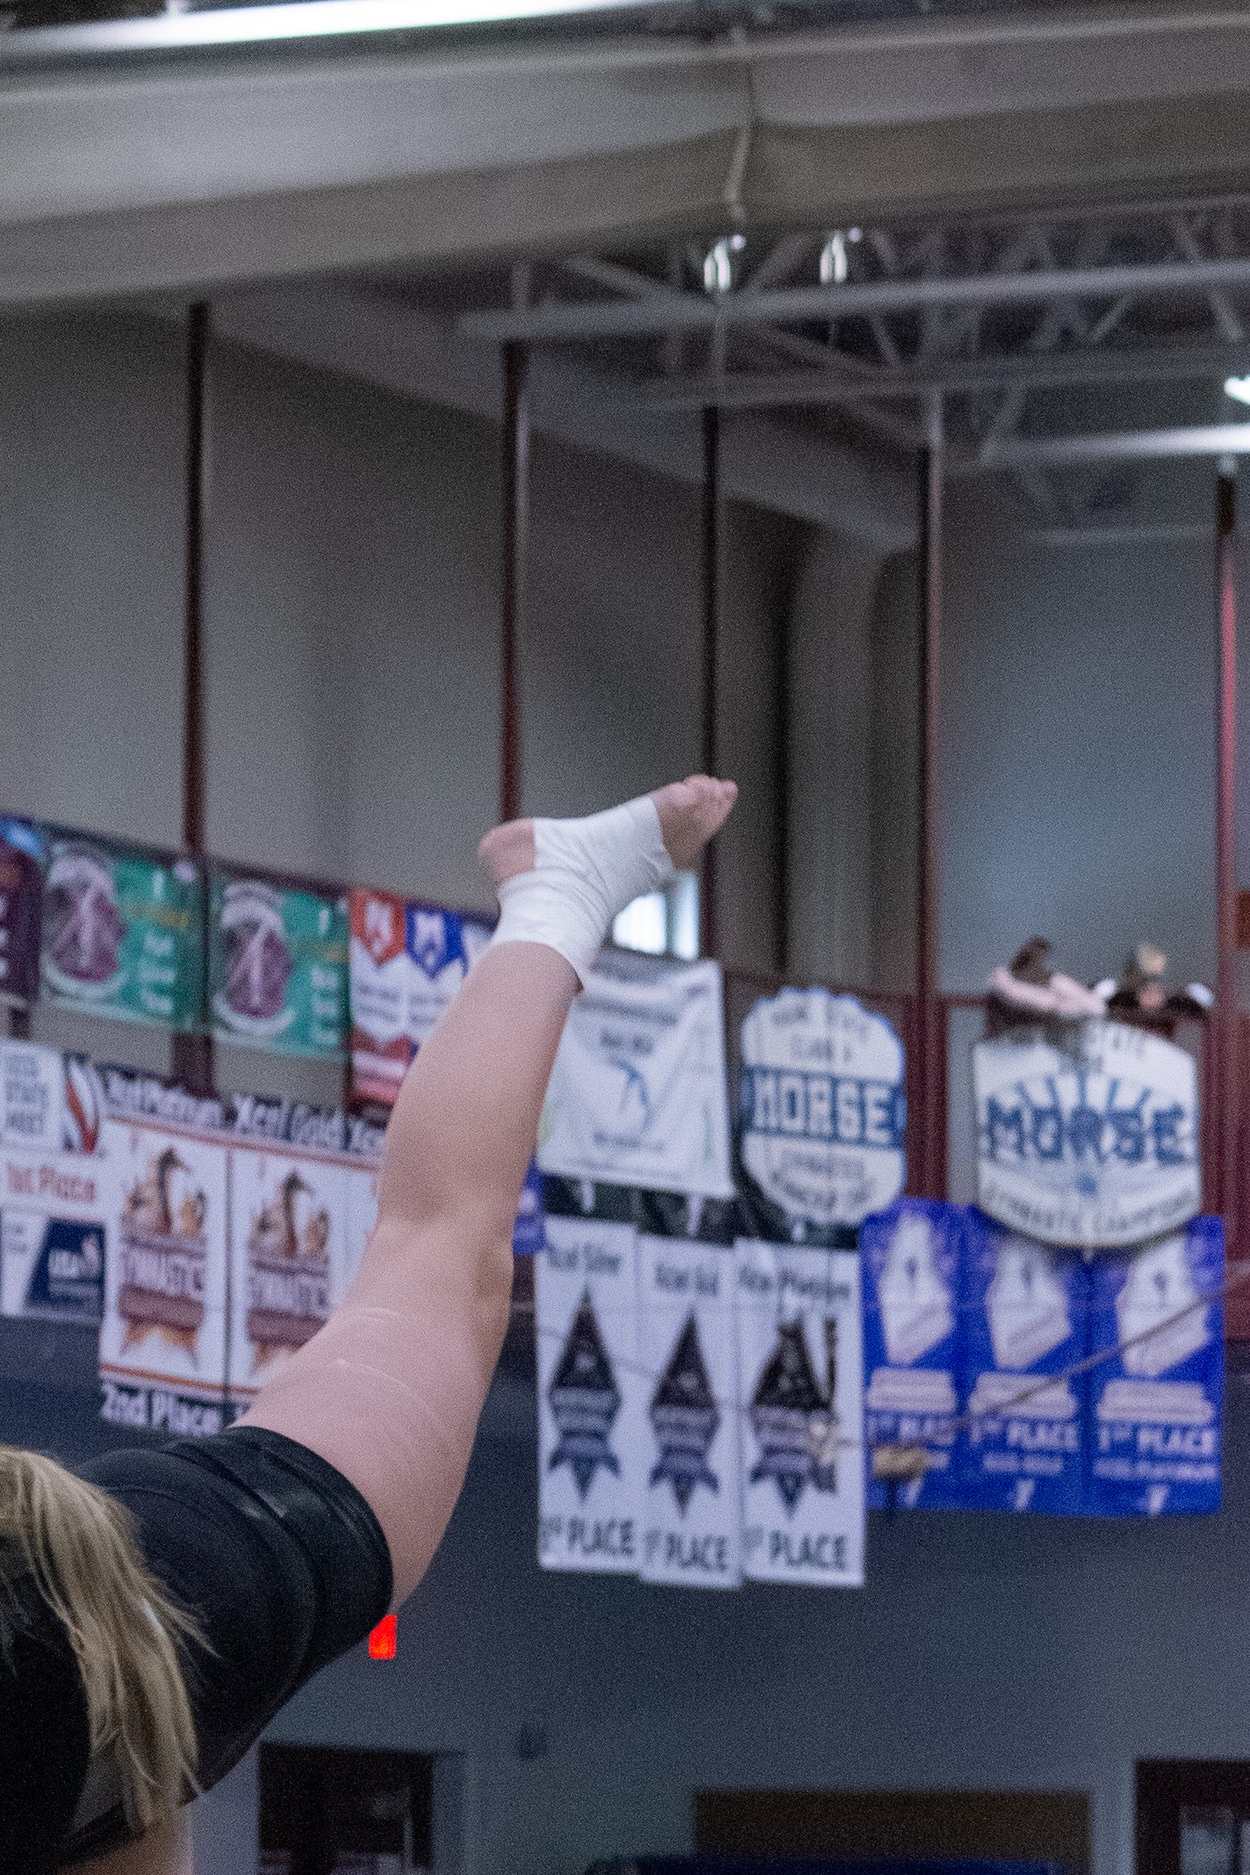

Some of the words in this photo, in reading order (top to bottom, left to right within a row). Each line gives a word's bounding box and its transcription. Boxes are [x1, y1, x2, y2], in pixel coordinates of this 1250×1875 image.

[752, 1070, 894, 1145] MORSE
[985, 1094, 1188, 1166] MORSE
[39, 1165, 97, 1205] Place
[101, 1382, 147, 1423] 2nd
[151, 1393, 222, 1435] Place
[1007, 1419, 1080, 1452] PLACE
[1136, 1427, 1217, 1457] PLACE
[567, 1517, 636, 1557] PLACE
[665, 1532, 729, 1573] PLACE
[768, 1530, 848, 1573] PLACE
